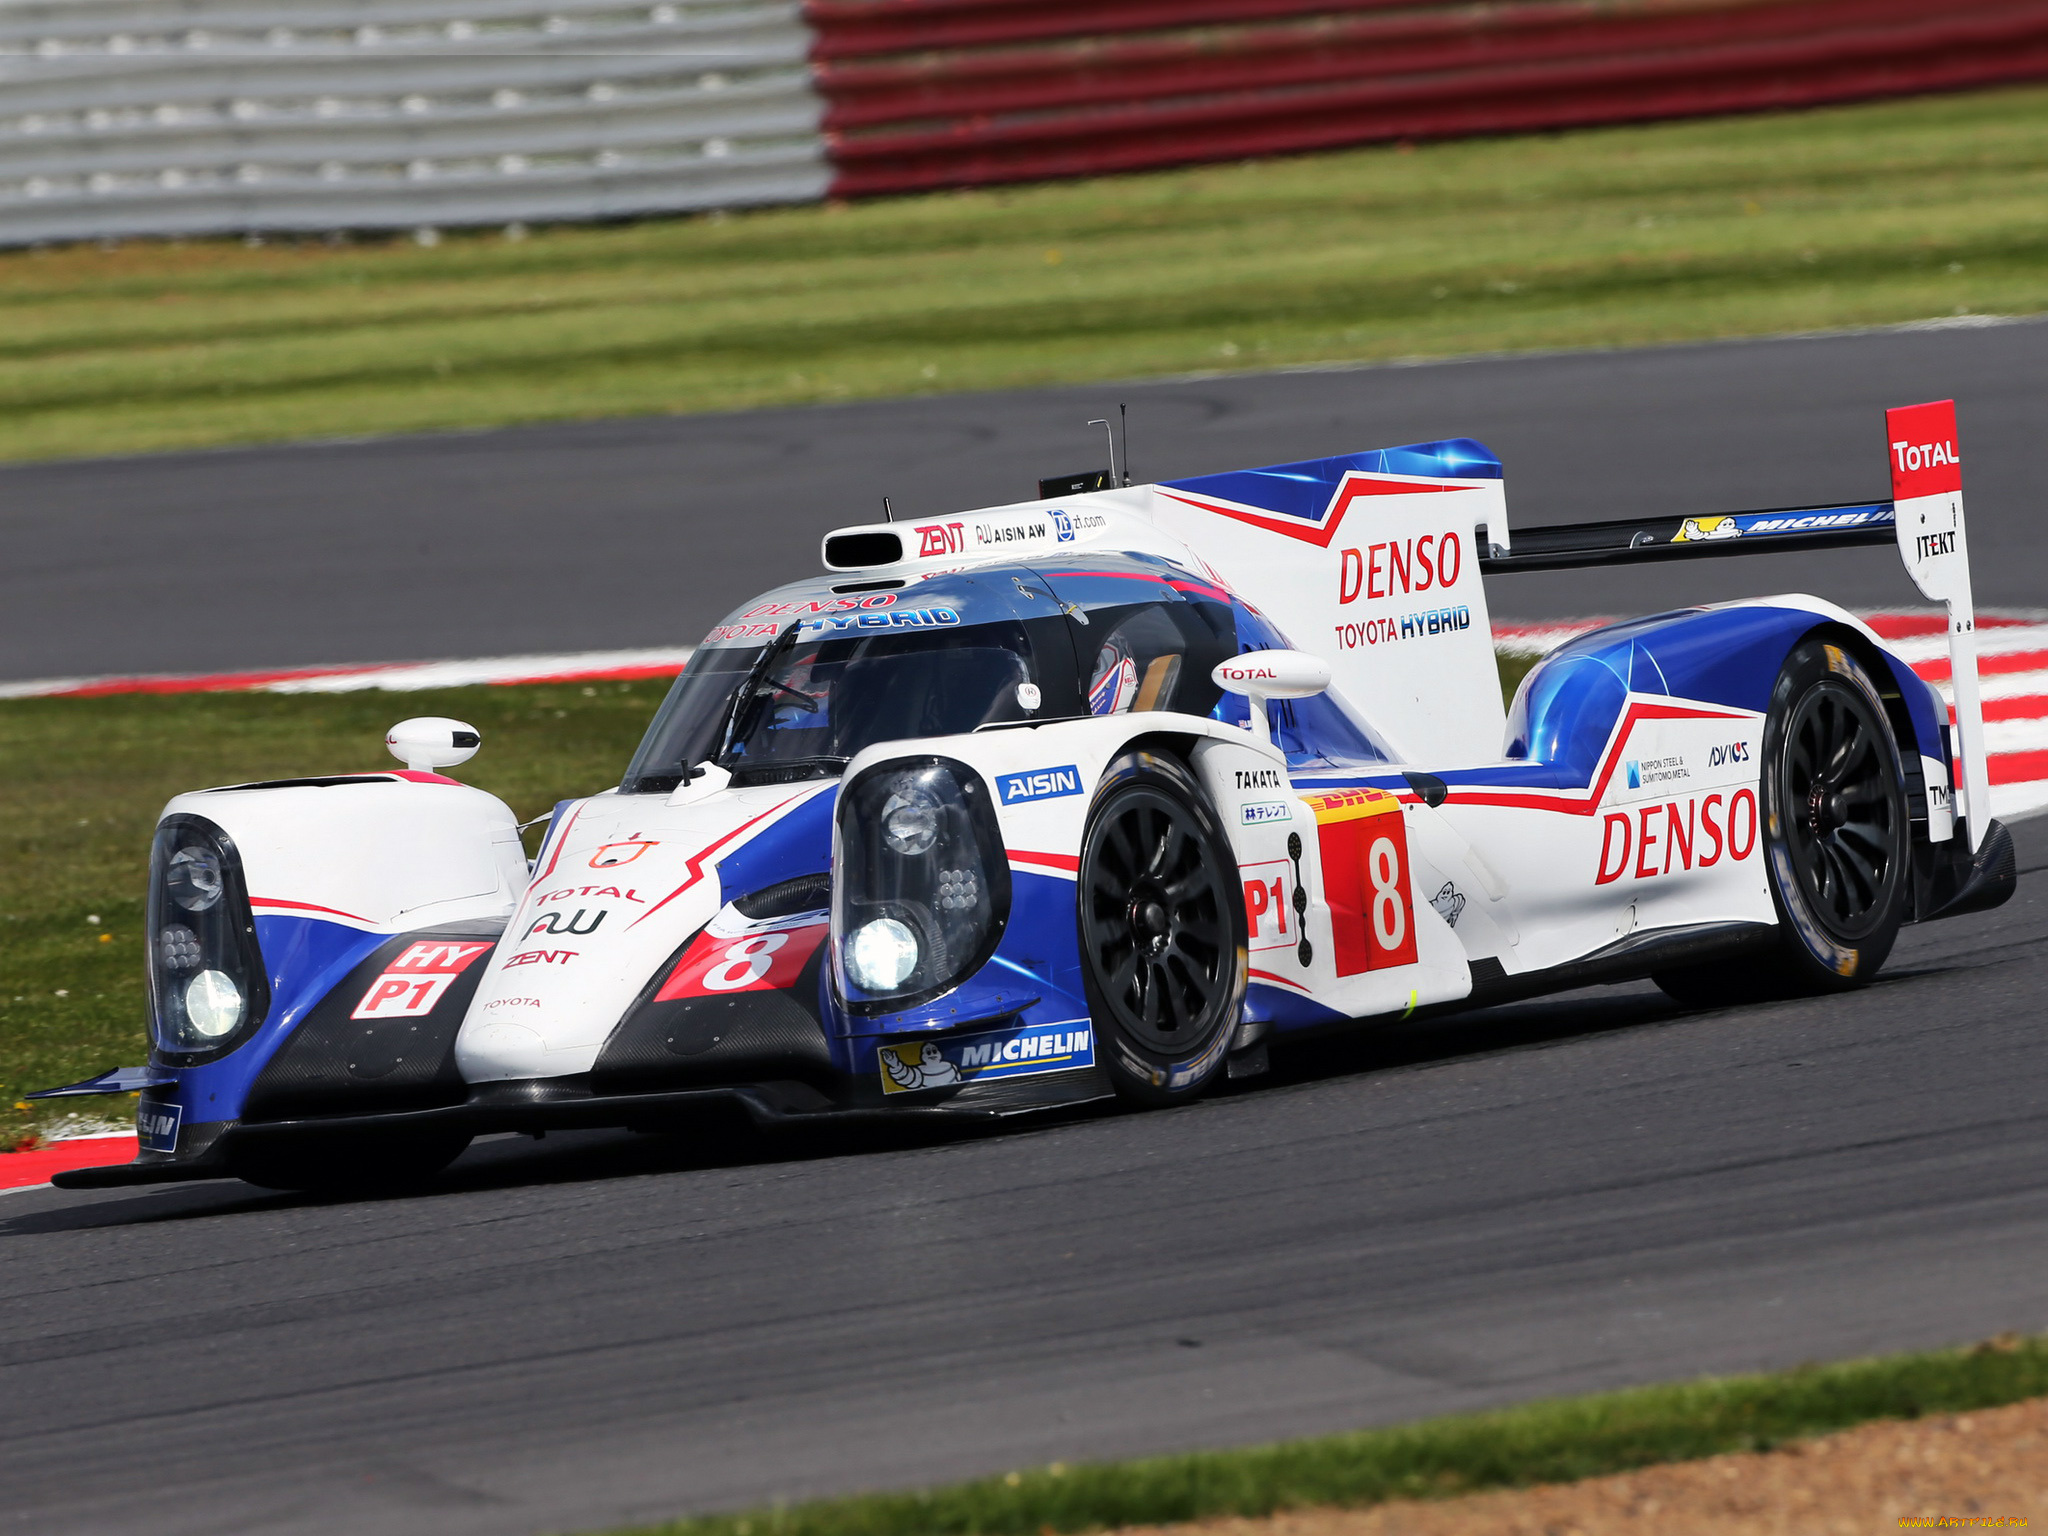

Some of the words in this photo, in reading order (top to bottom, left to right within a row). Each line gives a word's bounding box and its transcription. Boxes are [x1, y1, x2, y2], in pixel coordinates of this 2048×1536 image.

[1893, 440, 1960, 472] TOTAL
[914, 522, 965, 557] ZENT
[994, 525, 1025, 543] AISIN
[1028, 523, 1046, 538] AW
[1916, 531, 1956, 565] JTEKT
[1339, 532, 1460, 604] DENSO
[739, 593, 898, 620] DENSO
[795, 607, 961, 635] HYBRID
[1335, 617, 1397, 649] TOYOTA
[1400, 605, 1470, 639] HYBRID
[1219, 667, 1277, 681] TOTAL
[1641, 760, 1662, 771] NIPPON
[1662, 757, 1679, 768] STEEL
[1708, 742, 1749, 767] ADVICS
[1007, 769, 1076, 799] AISIN
[1235, 770, 1281, 789] TAKATA
[1642, 770, 1672, 784] SUMITOMO
[1672, 768, 1690, 780] METAL
[1313, 788, 1383, 809] DHL
[1929, 785, 1950, 805] TM
[1595, 788, 1757, 885] DENSO
[537, 885, 645, 907] TOTAL
[1243, 876, 1287, 938] P1
[1369, 837, 1405, 950] 8
[394, 946, 484, 969] HY
[501, 949, 580, 971] ZENT
[702, 933, 789, 990] 8
[365, 980, 435, 1011] P1
[483, 997, 541, 1012] TOYOTA
[962, 1030, 1090, 1067] MICHELIN
